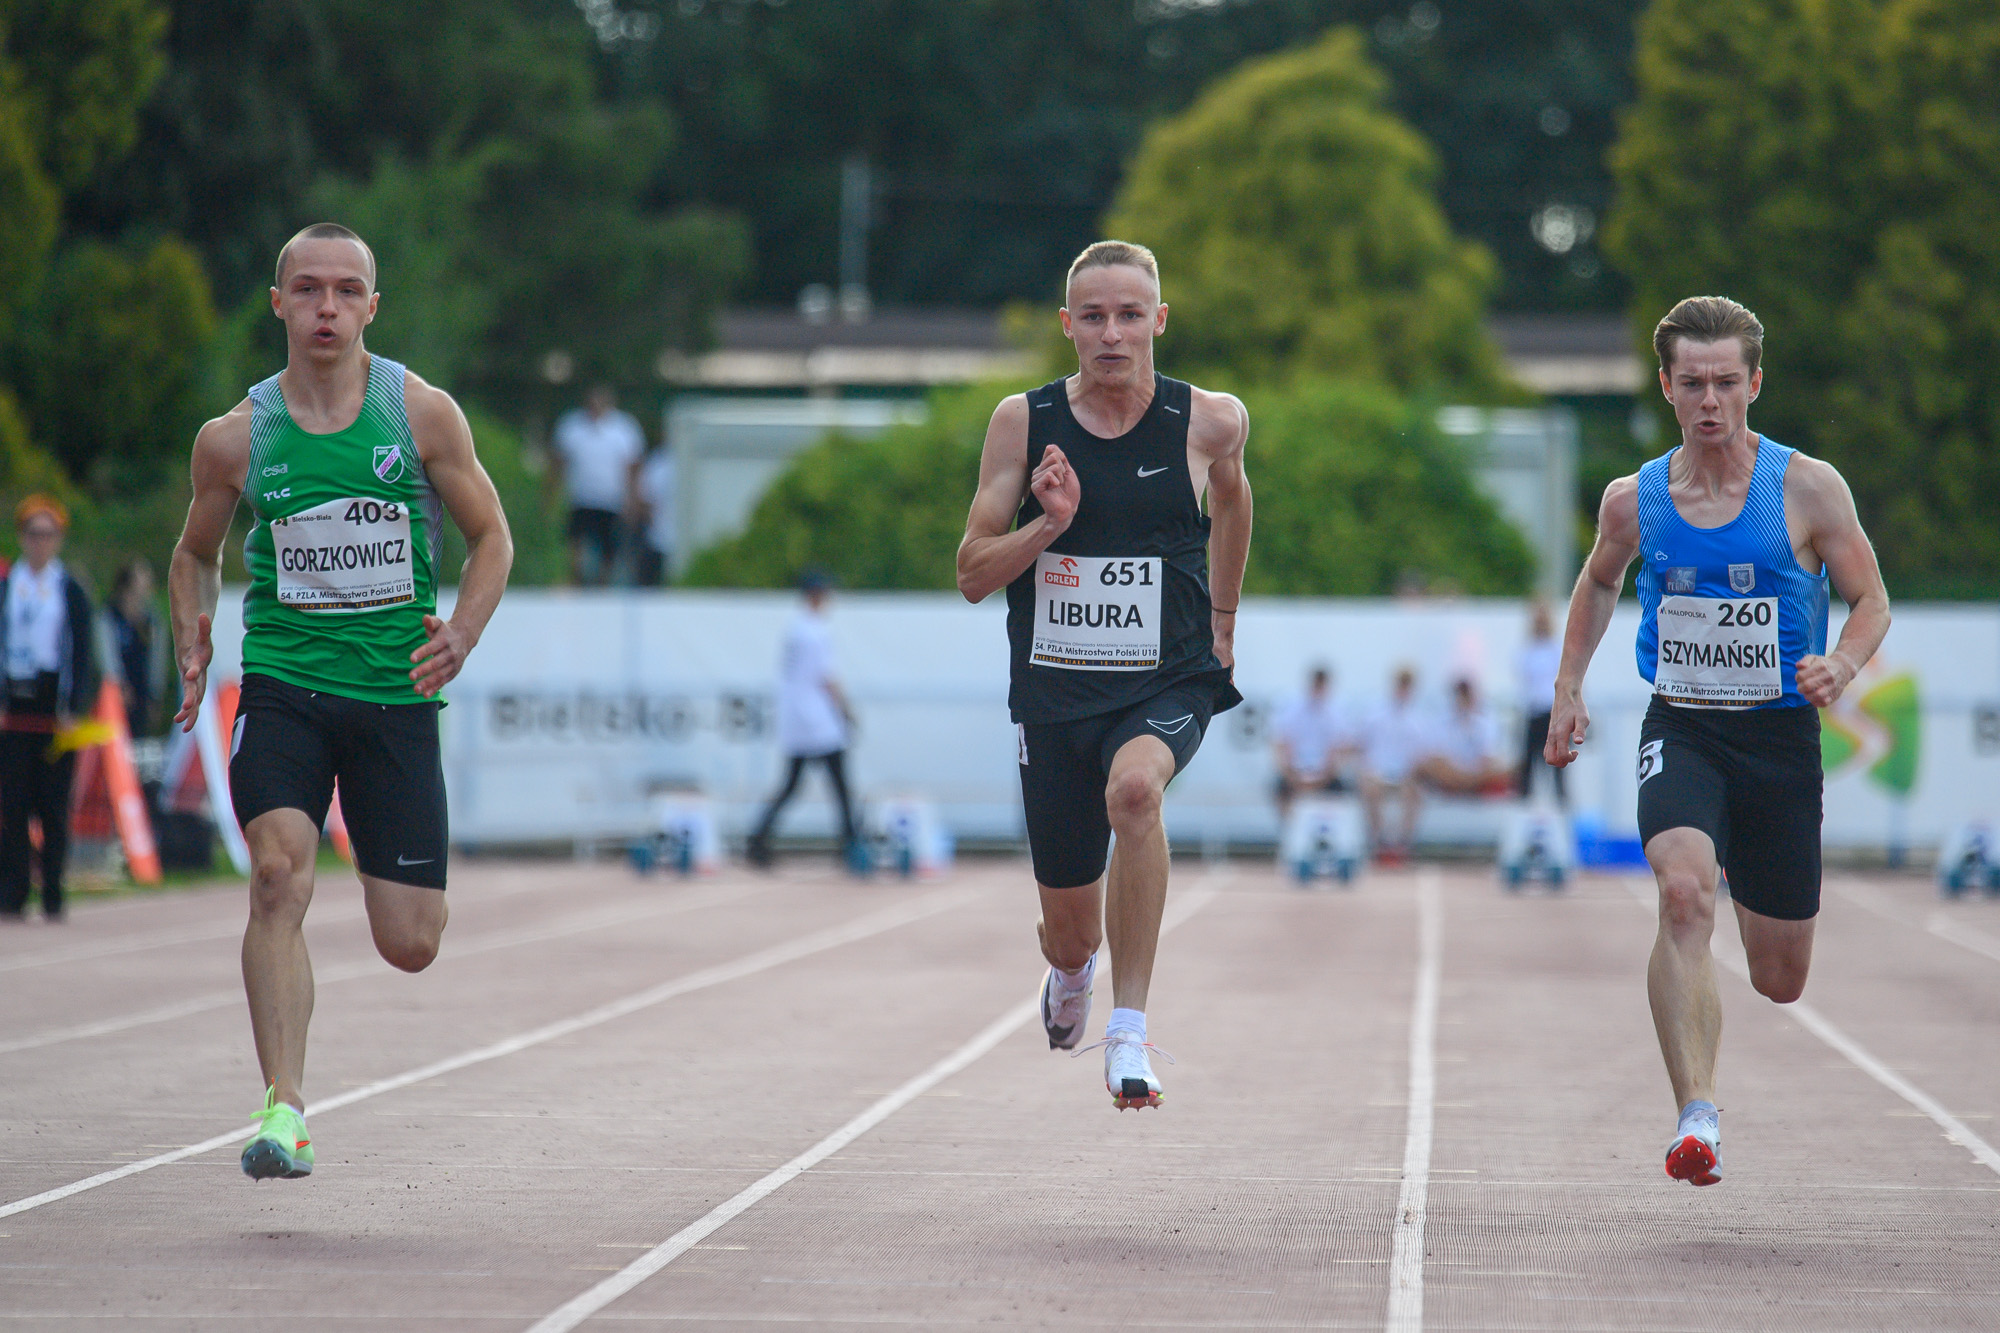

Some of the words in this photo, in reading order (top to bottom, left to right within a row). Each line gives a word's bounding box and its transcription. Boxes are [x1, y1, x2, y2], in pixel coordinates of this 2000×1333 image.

[263, 487, 291, 502] TLC
[291, 514, 332, 523] Bielsko-Biała
[344, 501, 401, 526] 403
[281, 538, 406, 573] GORZKOWICZ
[1046, 573, 1077, 586] ORLEN
[1100, 562, 1153, 586] 651
[280, 592, 294, 600] 54.
[296, 591, 317, 600] PZLA
[319, 589, 368, 600] Mistrzostwa
[370, 585, 394, 597] Polski
[396, 582, 412, 593] U18
[1048, 599, 1144, 629] LIBURA
[1667, 609, 1707, 619] MAŁOPOLSKA
[1717, 602, 1772, 627] 260
[1034, 642, 1046, 651] 54.
[1047, 644, 1063, 654] PZLA
[1064, 647, 1113, 657] Mistrzostwa
[1115, 648, 1140, 657] Polski
[1141, 648, 1158, 657] U18
[1662, 639, 1776, 669] SZYMAŃSKI
[1657, 683, 1669, 693] 54.
[1671, 685, 1689, 694] PZLA
[1690, 687, 1736, 697] Mistrzostwa
[1737, 688, 1762, 697] Polski
[1763, 688, 1780, 697] U18
